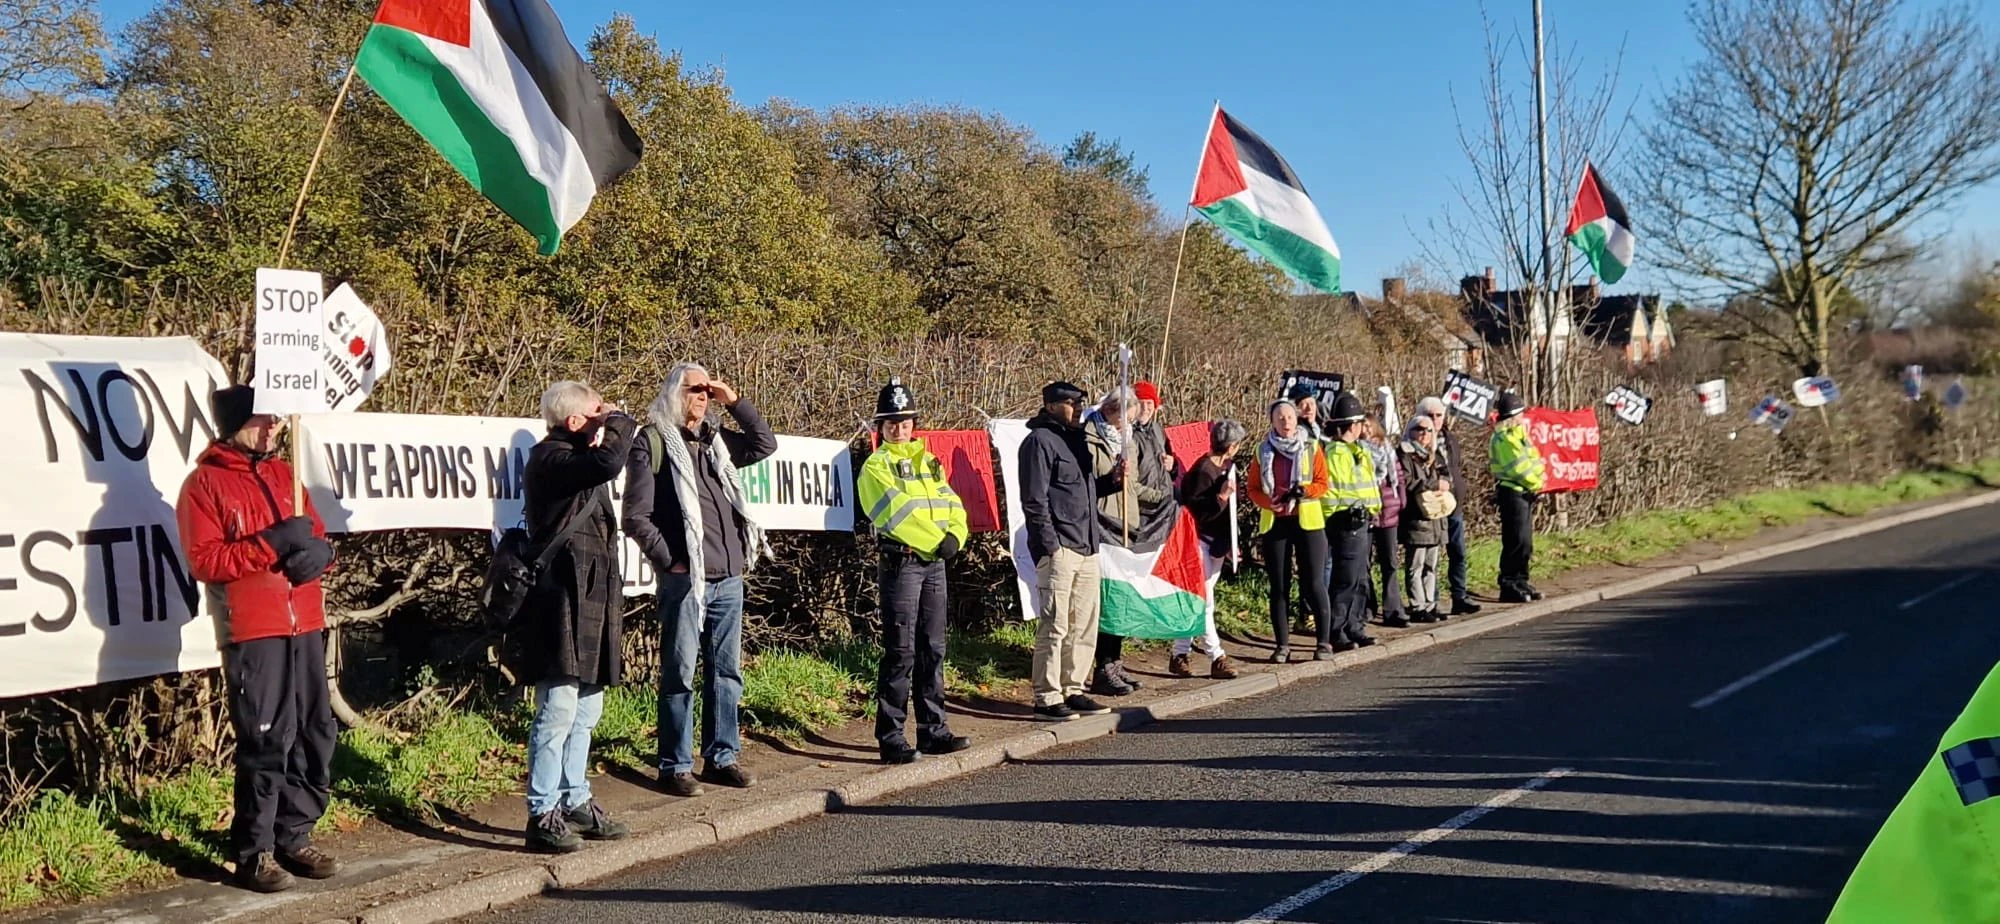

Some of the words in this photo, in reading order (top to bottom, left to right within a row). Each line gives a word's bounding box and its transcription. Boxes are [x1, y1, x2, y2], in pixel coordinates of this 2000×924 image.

[262, 287, 318, 313] STOP
[262, 328, 319, 351] arming
[265, 369, 318, 390] Israel
[19, 368, 217, 465] NOW
[323, 443, 477, 500] WEAPONS
[776, 460, 795, 505] IN
[800, 462, 844, 508] GAZA
